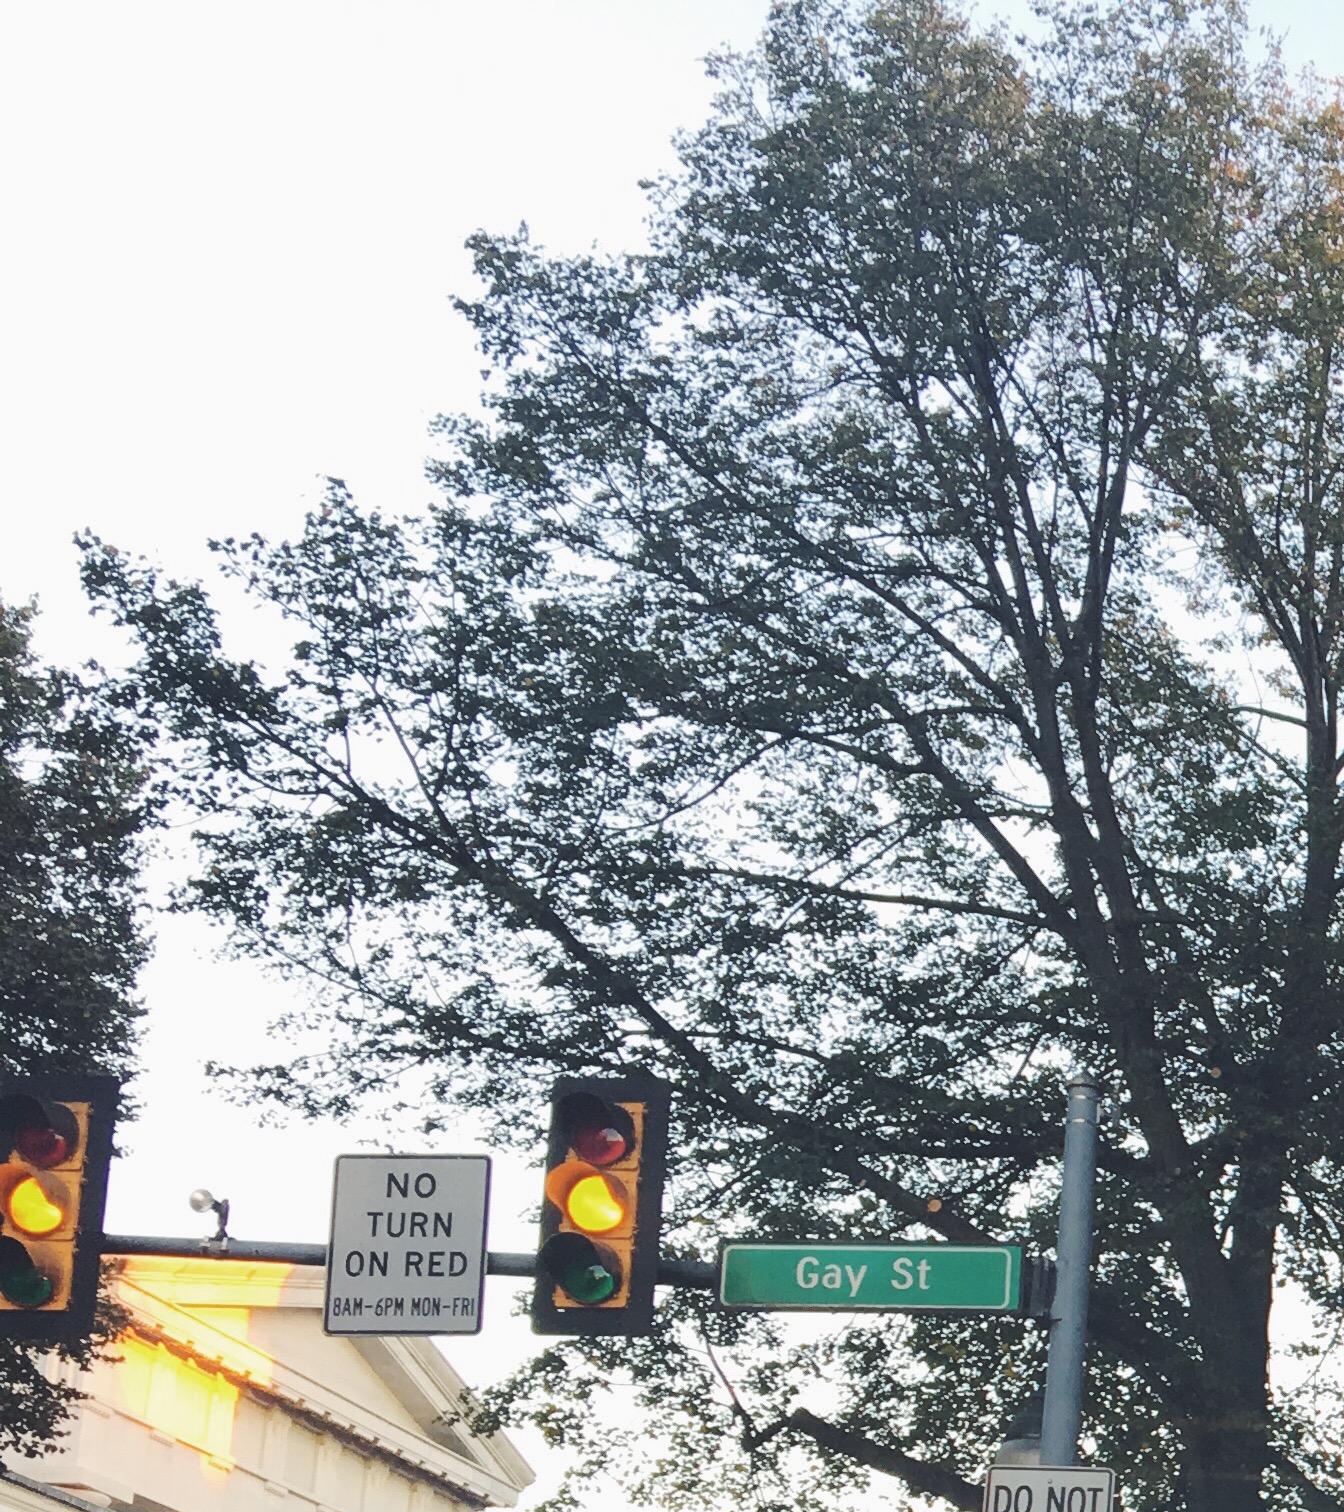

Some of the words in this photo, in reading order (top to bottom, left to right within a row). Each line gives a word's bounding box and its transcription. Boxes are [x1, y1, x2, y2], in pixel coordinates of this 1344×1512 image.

[386, 1172, 437, 1199] NO
[367, 1211, 453, 1238] TURN
[345, 1250, 389, 1277] ON
[404, 1250, 468, 1277] RED
[796, 1256, 868, 1298] Gay
[890, 1257, 932, 1290] St
[332, 1297, 404, 1317] 8AM-6PM
[410, 1297, 475, 1317] MON-FRI
